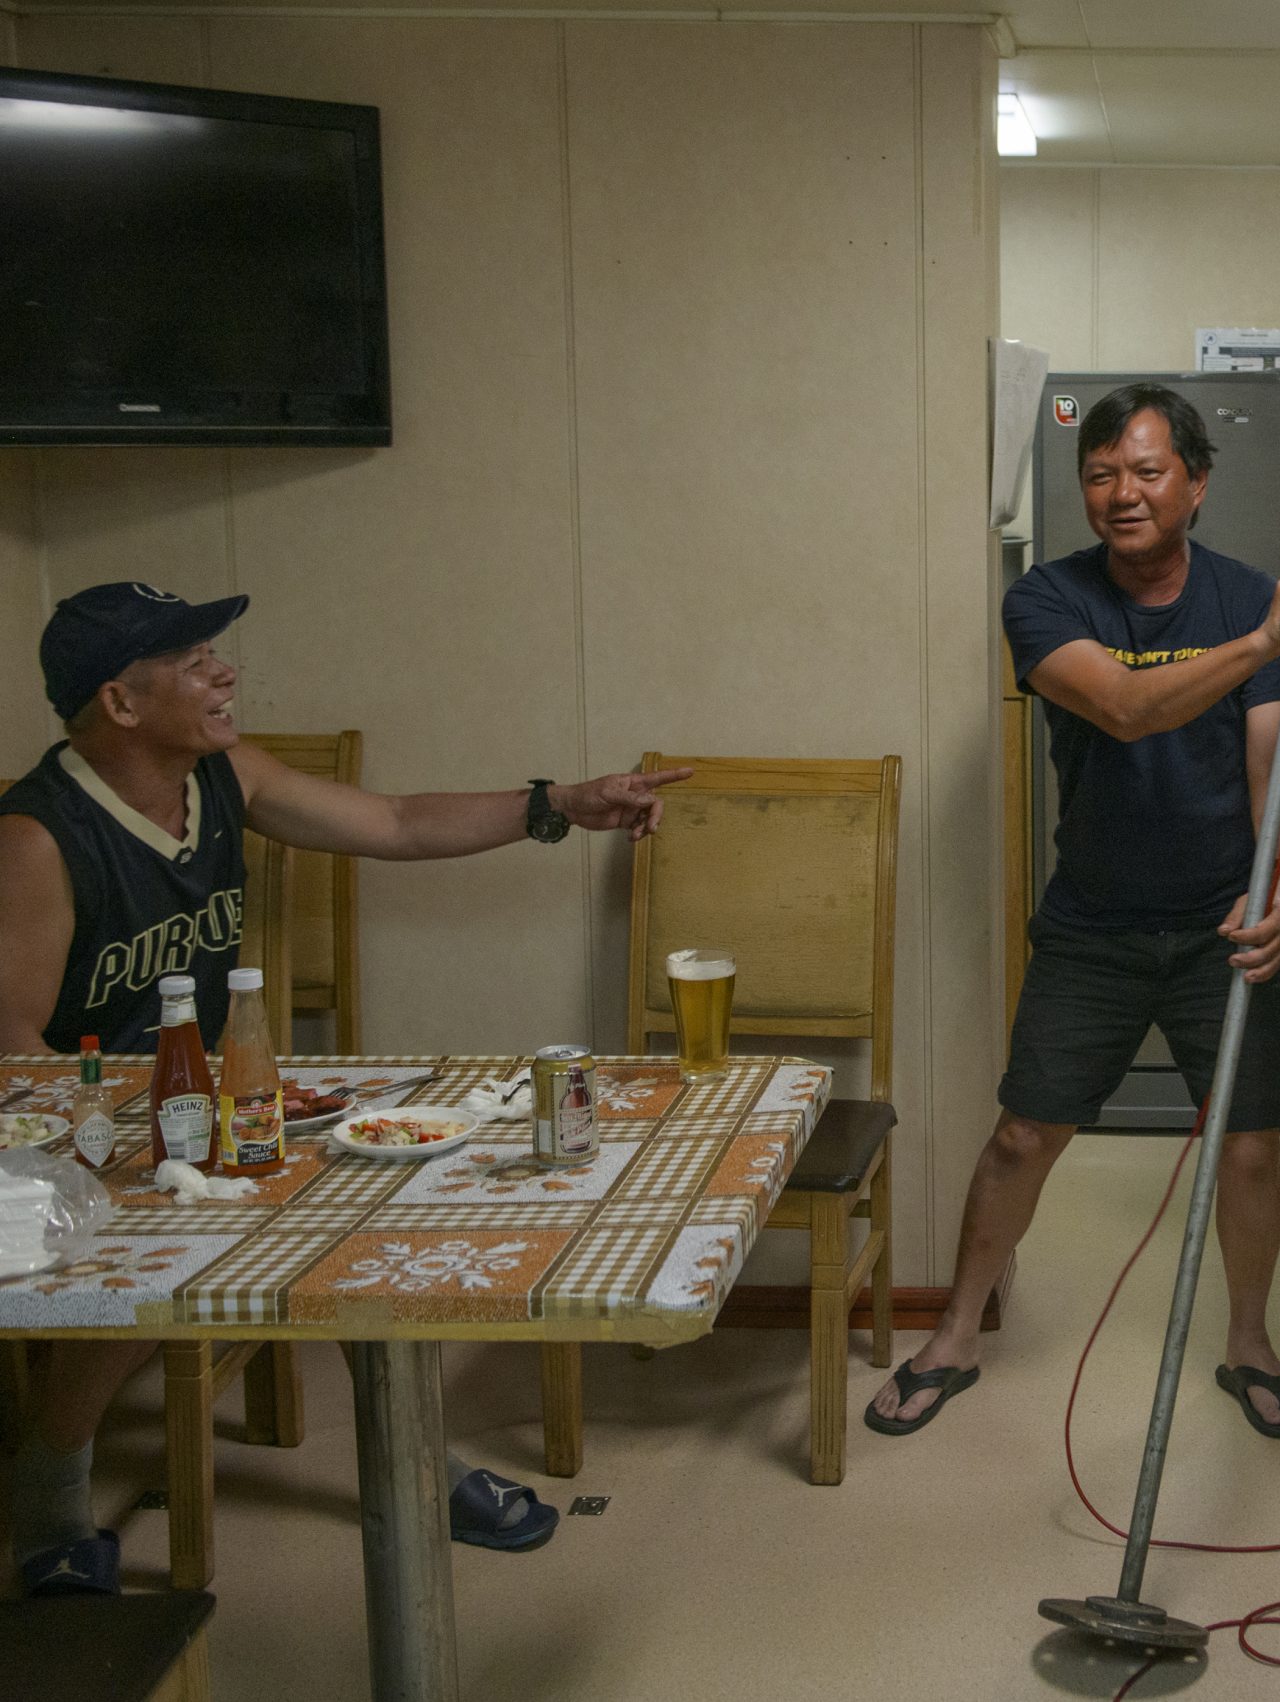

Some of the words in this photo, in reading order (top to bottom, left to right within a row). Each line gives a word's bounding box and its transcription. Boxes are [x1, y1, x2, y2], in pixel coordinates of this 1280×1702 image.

[172, 1101, 203, 1113] HEINZ
[239, 1145, 262, 1154] Sweet
[248, 1151, 272, 1159] Sauce
